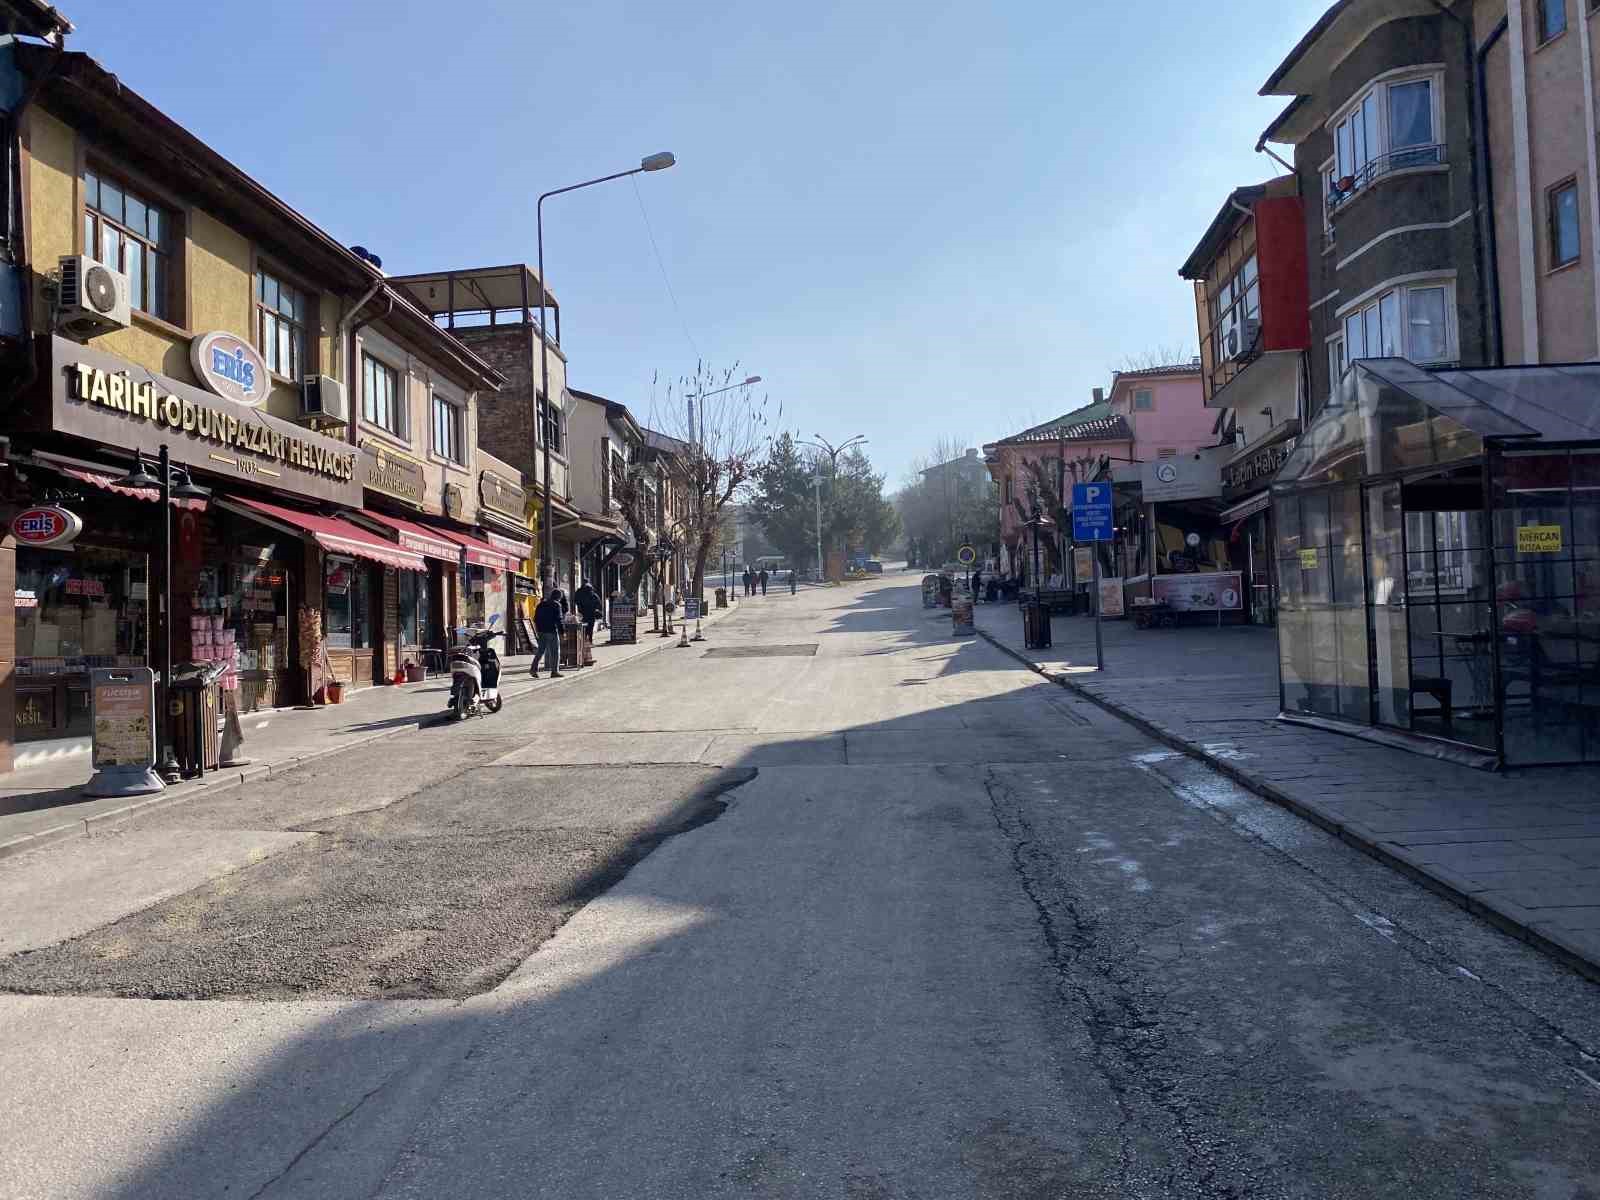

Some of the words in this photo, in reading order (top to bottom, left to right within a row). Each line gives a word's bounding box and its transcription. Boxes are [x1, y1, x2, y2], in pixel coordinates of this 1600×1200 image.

[212, 347, 255, 392] ERİŞ
[77, 361, 158, 420] TARİHİ
[1086, 486, 1100, 504] P
[20, 513, 54, 535] ERİŞ
